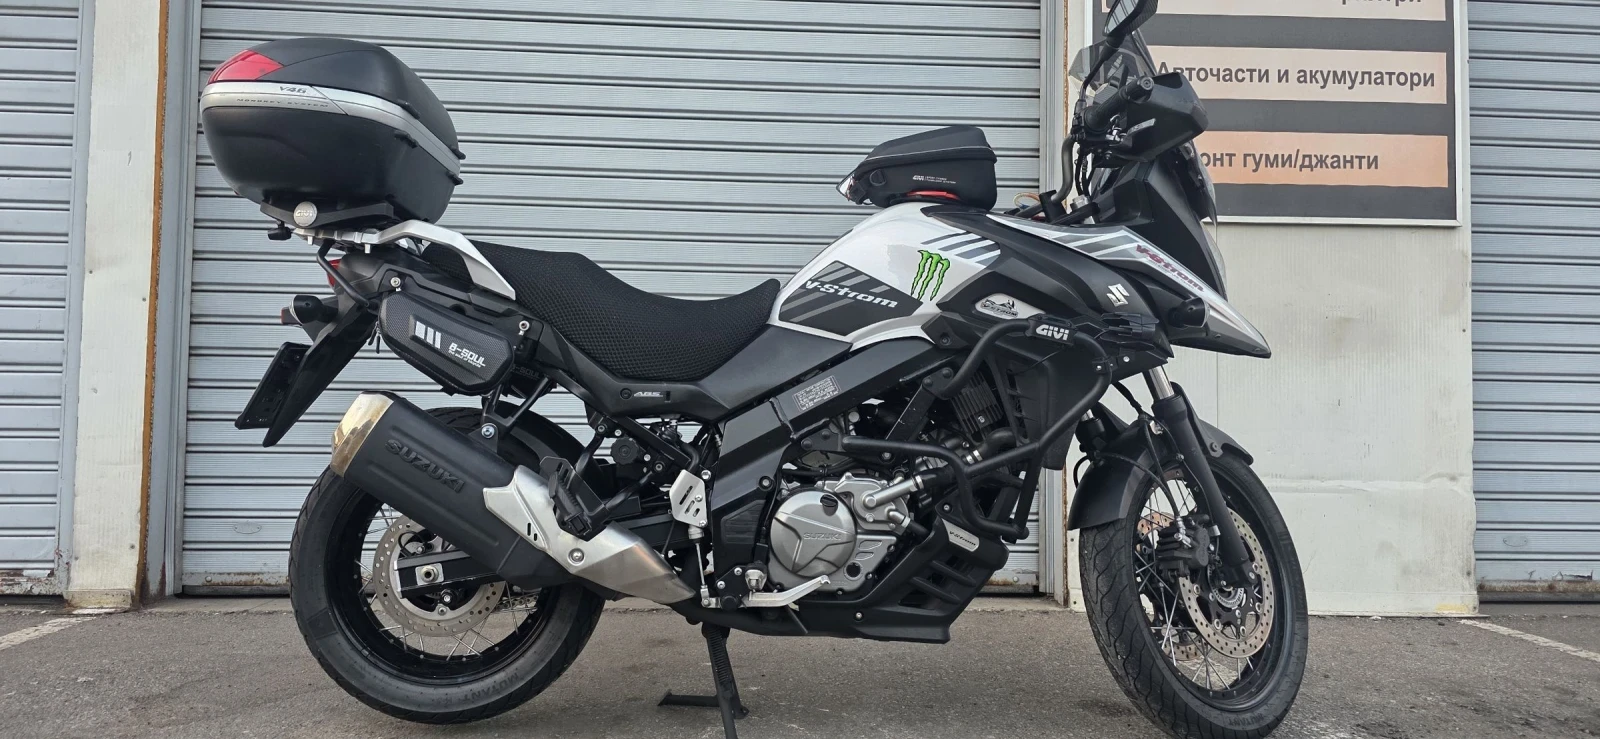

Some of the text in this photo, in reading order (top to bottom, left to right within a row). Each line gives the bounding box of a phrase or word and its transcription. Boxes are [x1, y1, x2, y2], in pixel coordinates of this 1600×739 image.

[1277, 68, 1289, 83] и
[1296, 69, 1435, 91] акумулатори
[1200, 149, 1379, 173] онт гуми/джанти
[805, 280, 898, 308] V-Strom
[1035, 323, 1070, 341] GIVI
[448, 342, 486, 367] B-SOUL
[384, 439, 465, 494] SUZUKI
[802, 532, 842, 541] SUZUKI
